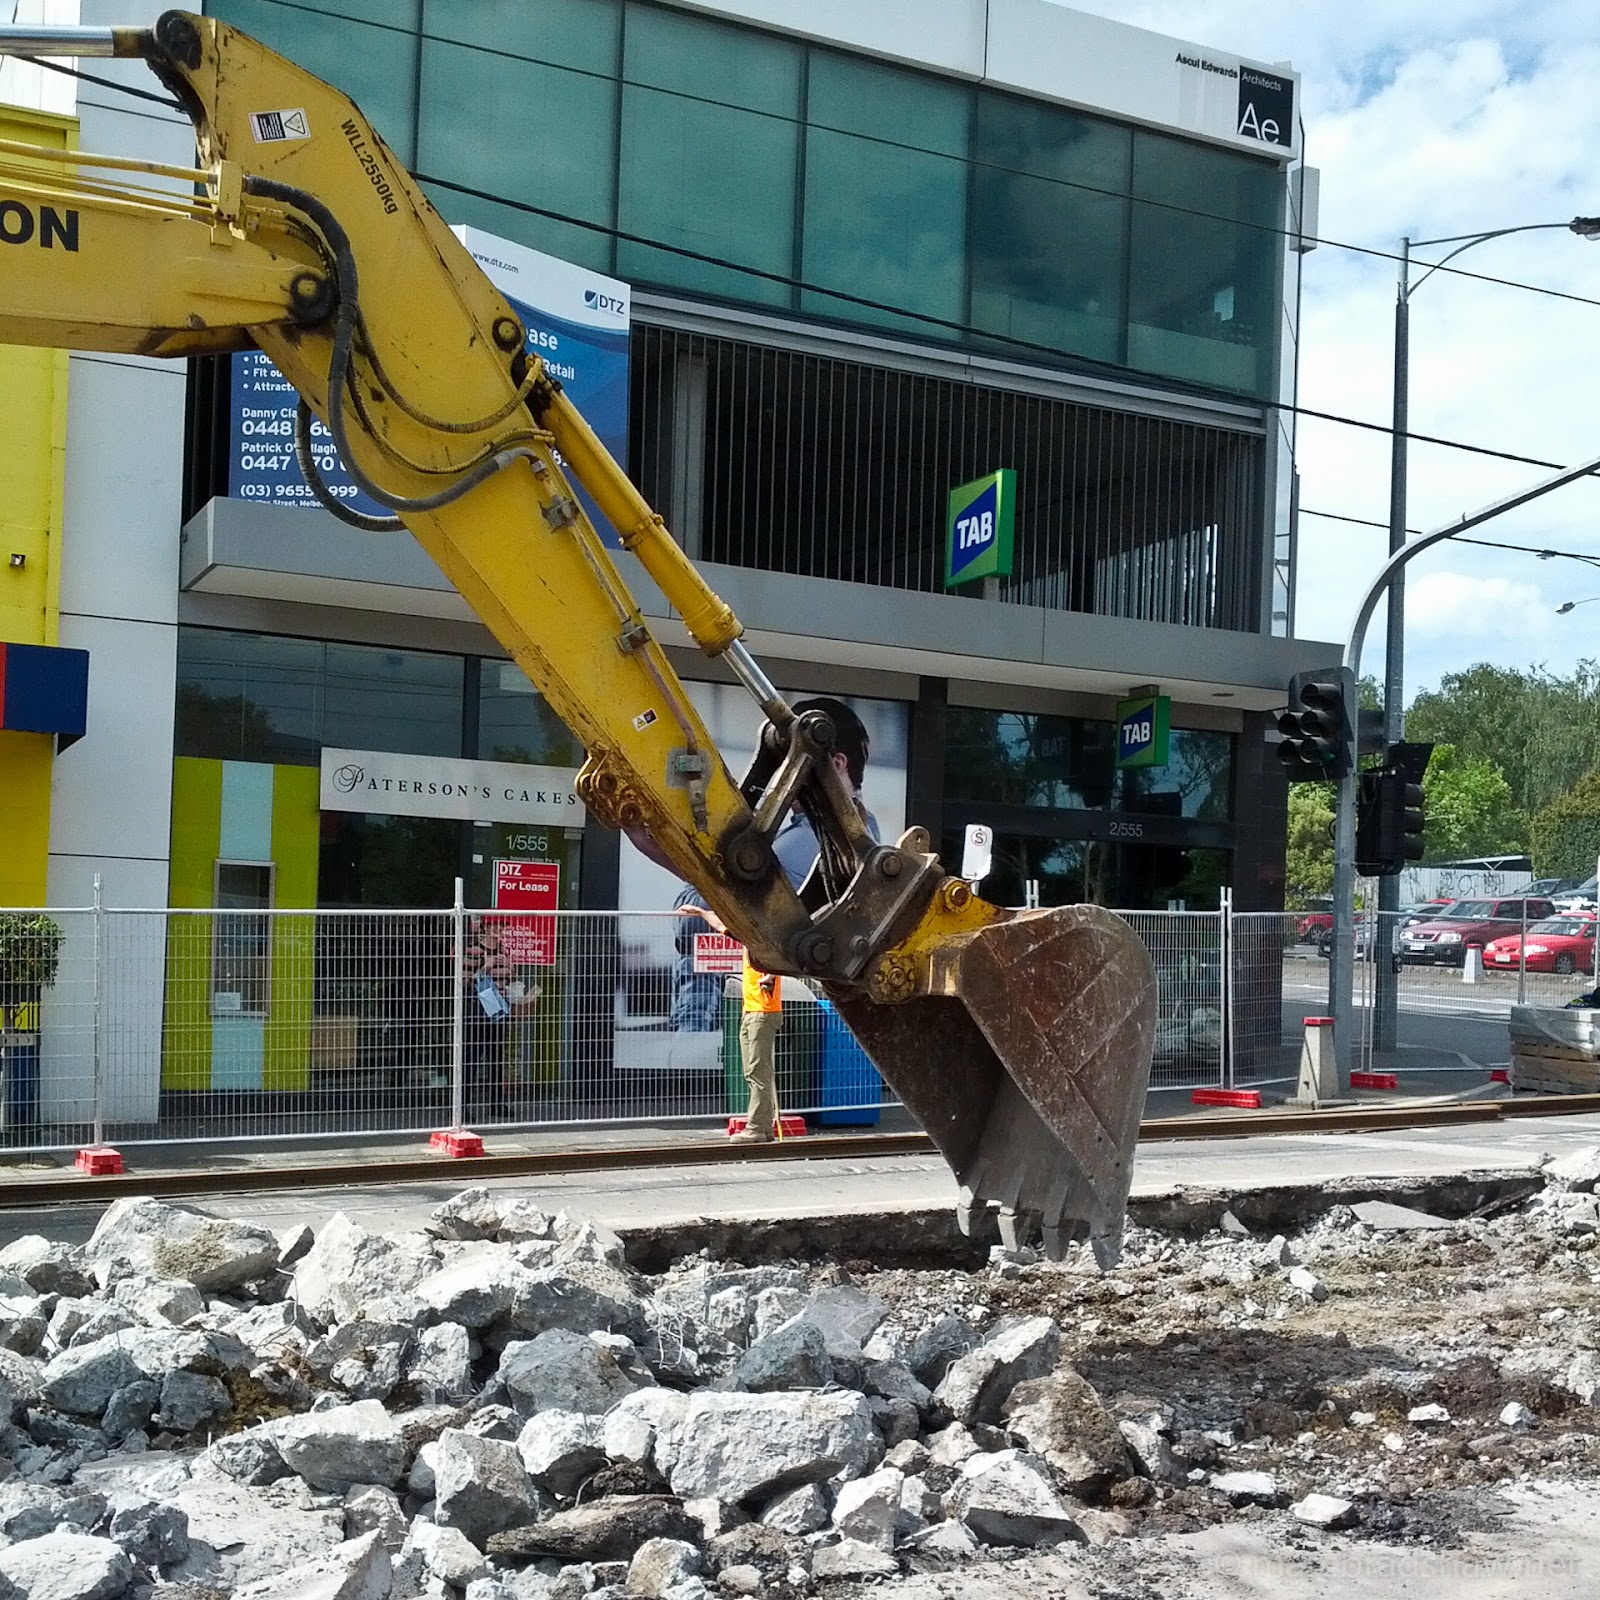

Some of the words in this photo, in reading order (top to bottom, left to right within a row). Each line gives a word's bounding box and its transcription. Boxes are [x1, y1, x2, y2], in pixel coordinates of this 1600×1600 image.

[1176, 53, 1200, 69] Ascul
[1201, 60, 1238, 79] Edwards
[1241, 71, 1282, 92] Architects
[1237, 102, 1280, 144] Ae
[599, 294, 625, 315] DTZ
[526, 328, 559, 351] ase
[252, 368, 267, 377] Fit
[270, 370, 283, 378] ou
[242, 407, 277, 419] Danny
[280, 408, 297, 418] Cla
[242, 421, 292, 435] 0448
[241, 442, 281, 453] Patrick
[241, 456, 291, 471] 0447
[240, 485, 271, 498] (03)
[957, 511, 993, 550] TAB
[1123, 721, 1151, 745] TAB
[504, 788, 577, 806] CAKES
[1109, 821, 1144, 837] 2/555
[506, 834, 549, 851] 1/555
[500, 863, 522, 876] DTZ
[500, 880, 517, 890] For
[519, 881, 549, 892] Lease
